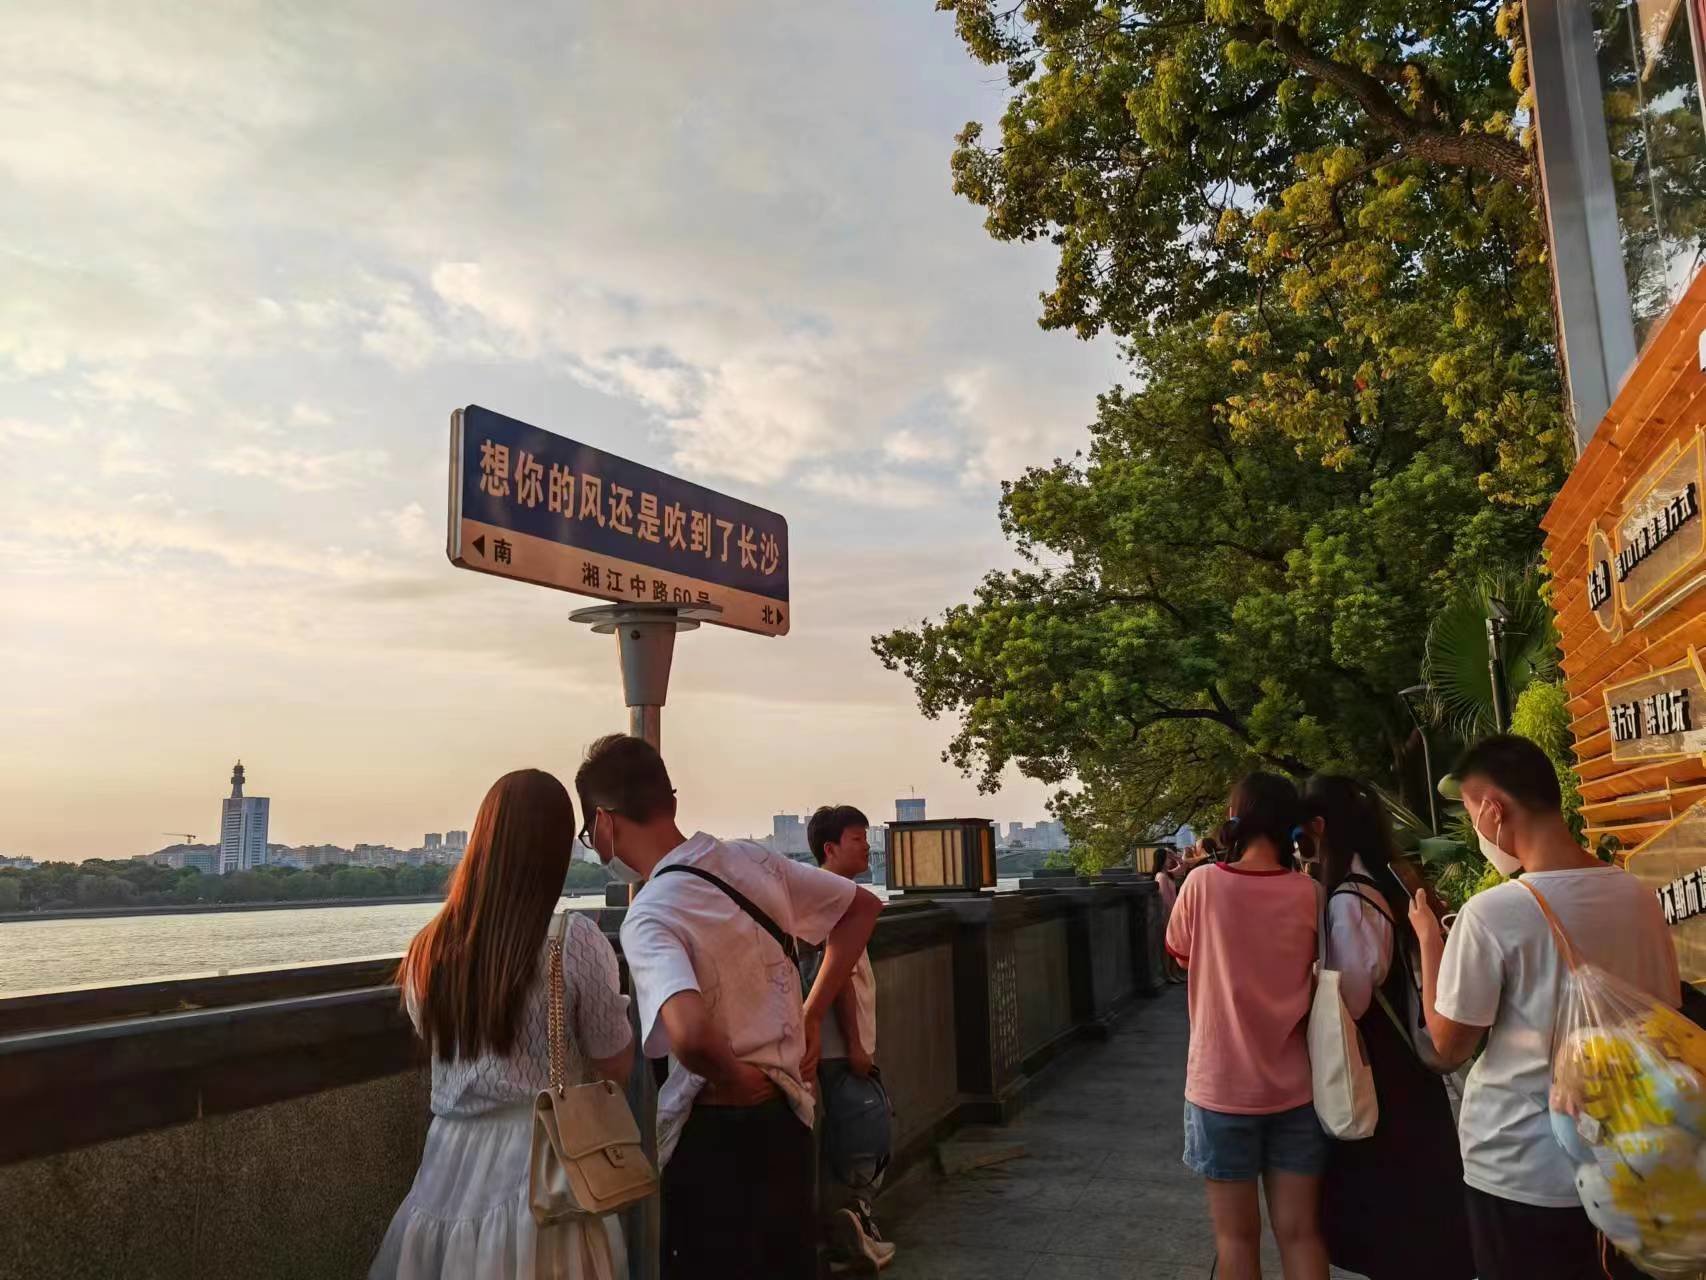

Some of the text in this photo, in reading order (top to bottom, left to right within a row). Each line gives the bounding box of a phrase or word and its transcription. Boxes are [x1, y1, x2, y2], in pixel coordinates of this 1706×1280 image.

[479, 438, 780, 576] 想你的风还是吹到了长沙
[493, 537, 775, 626] 南 湘江中路60号 北
